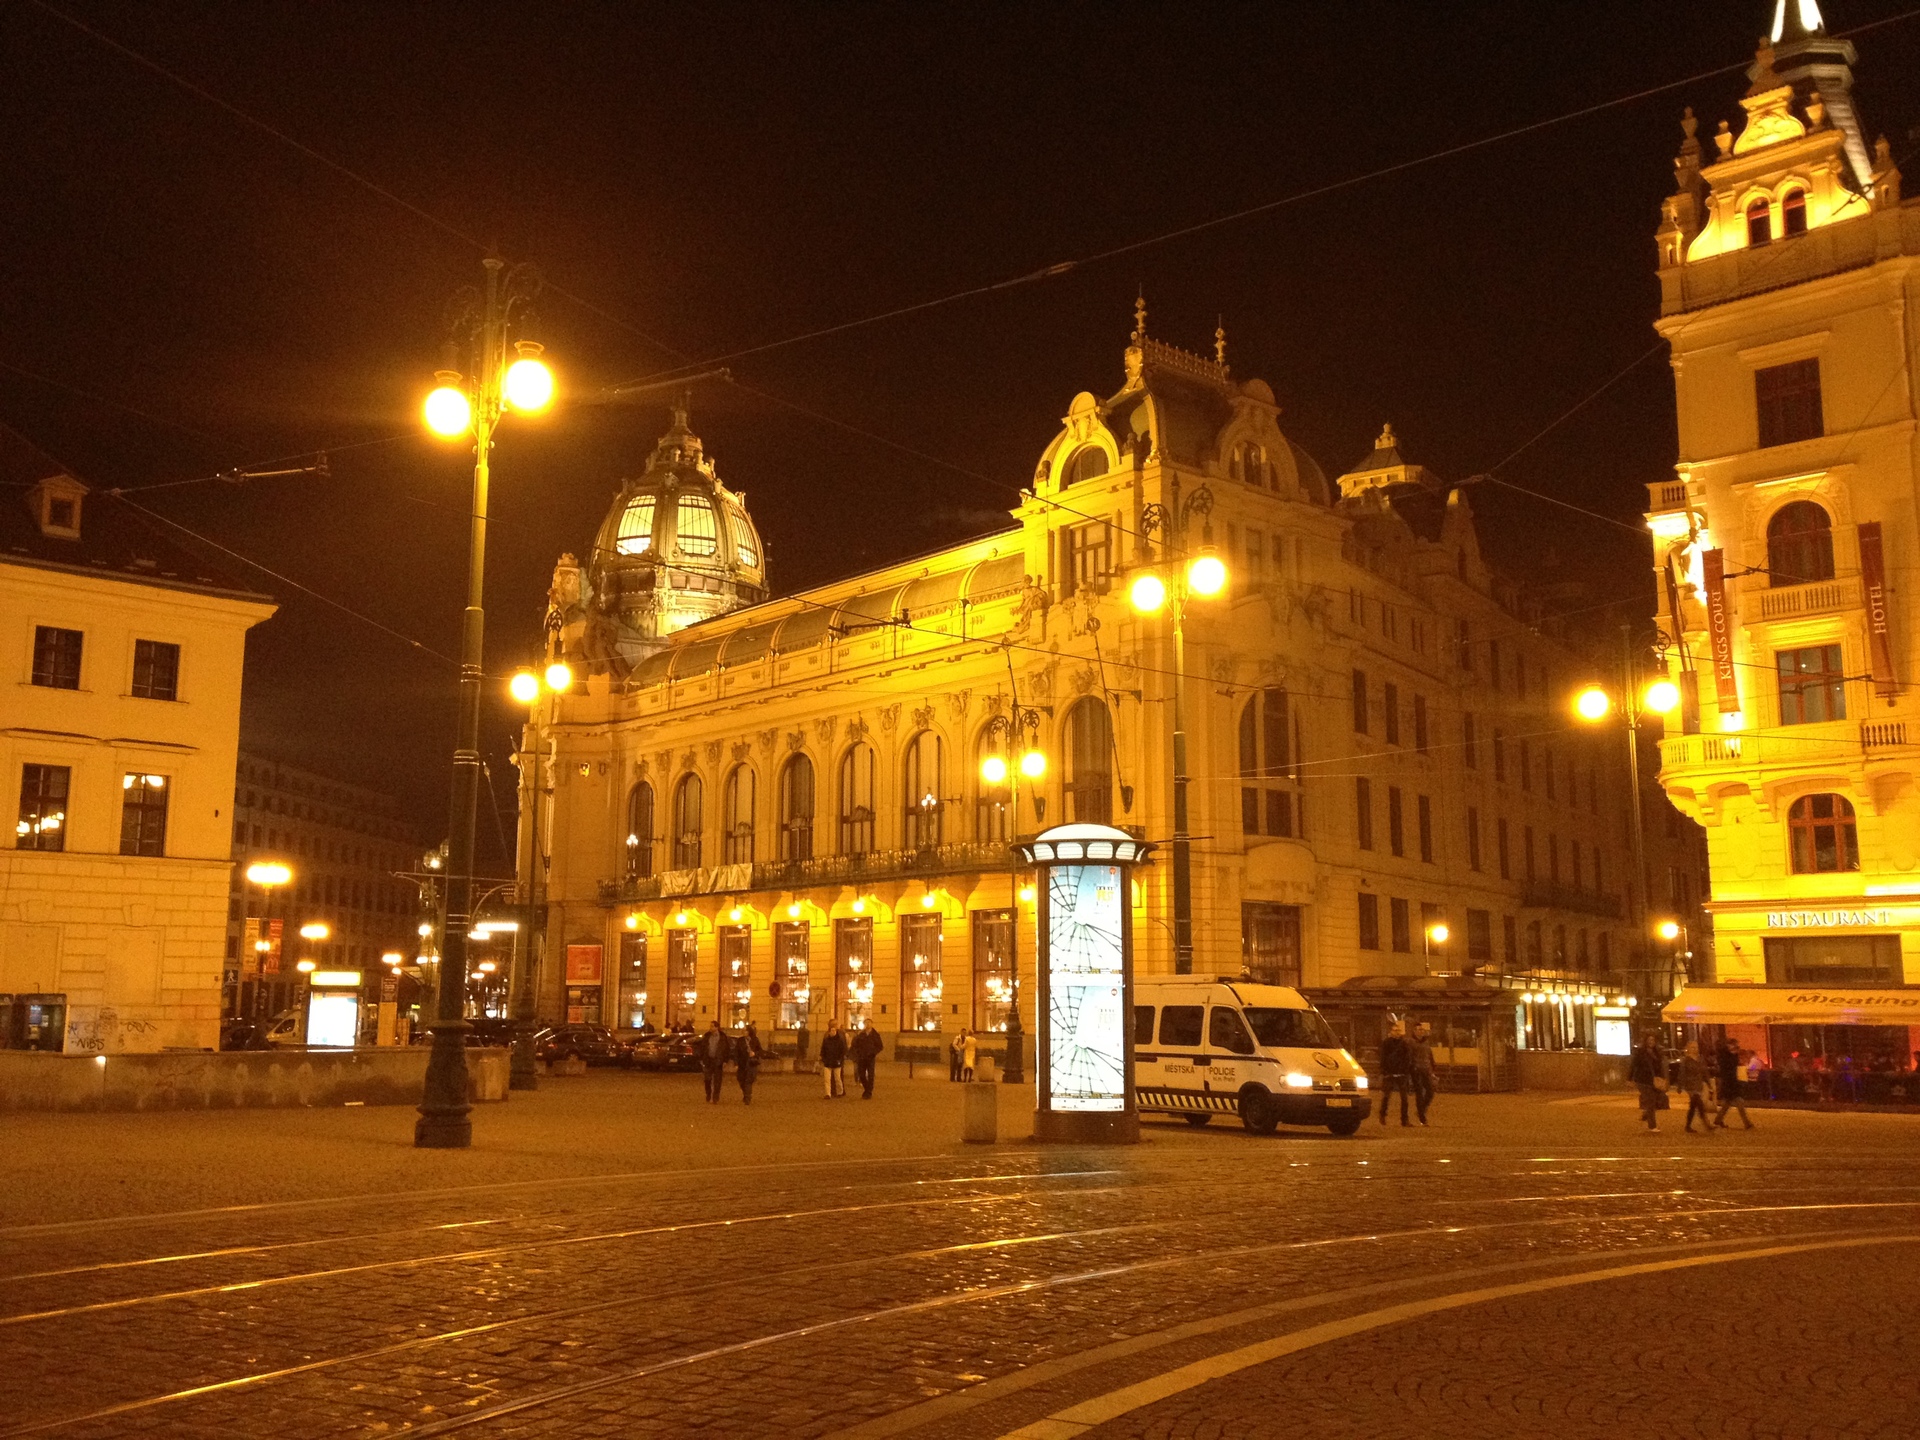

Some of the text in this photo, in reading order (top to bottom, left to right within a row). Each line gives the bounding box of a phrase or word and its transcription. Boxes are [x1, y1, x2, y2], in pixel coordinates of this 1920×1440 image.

[1869, 582, 1887, 634] HOTEL
[1712, 589, 1732, 680] KINGS COURT
[1767, 910, 1889, 927] RESTAURANT
[1209, 1066, 1236, 1076] POLICIE
